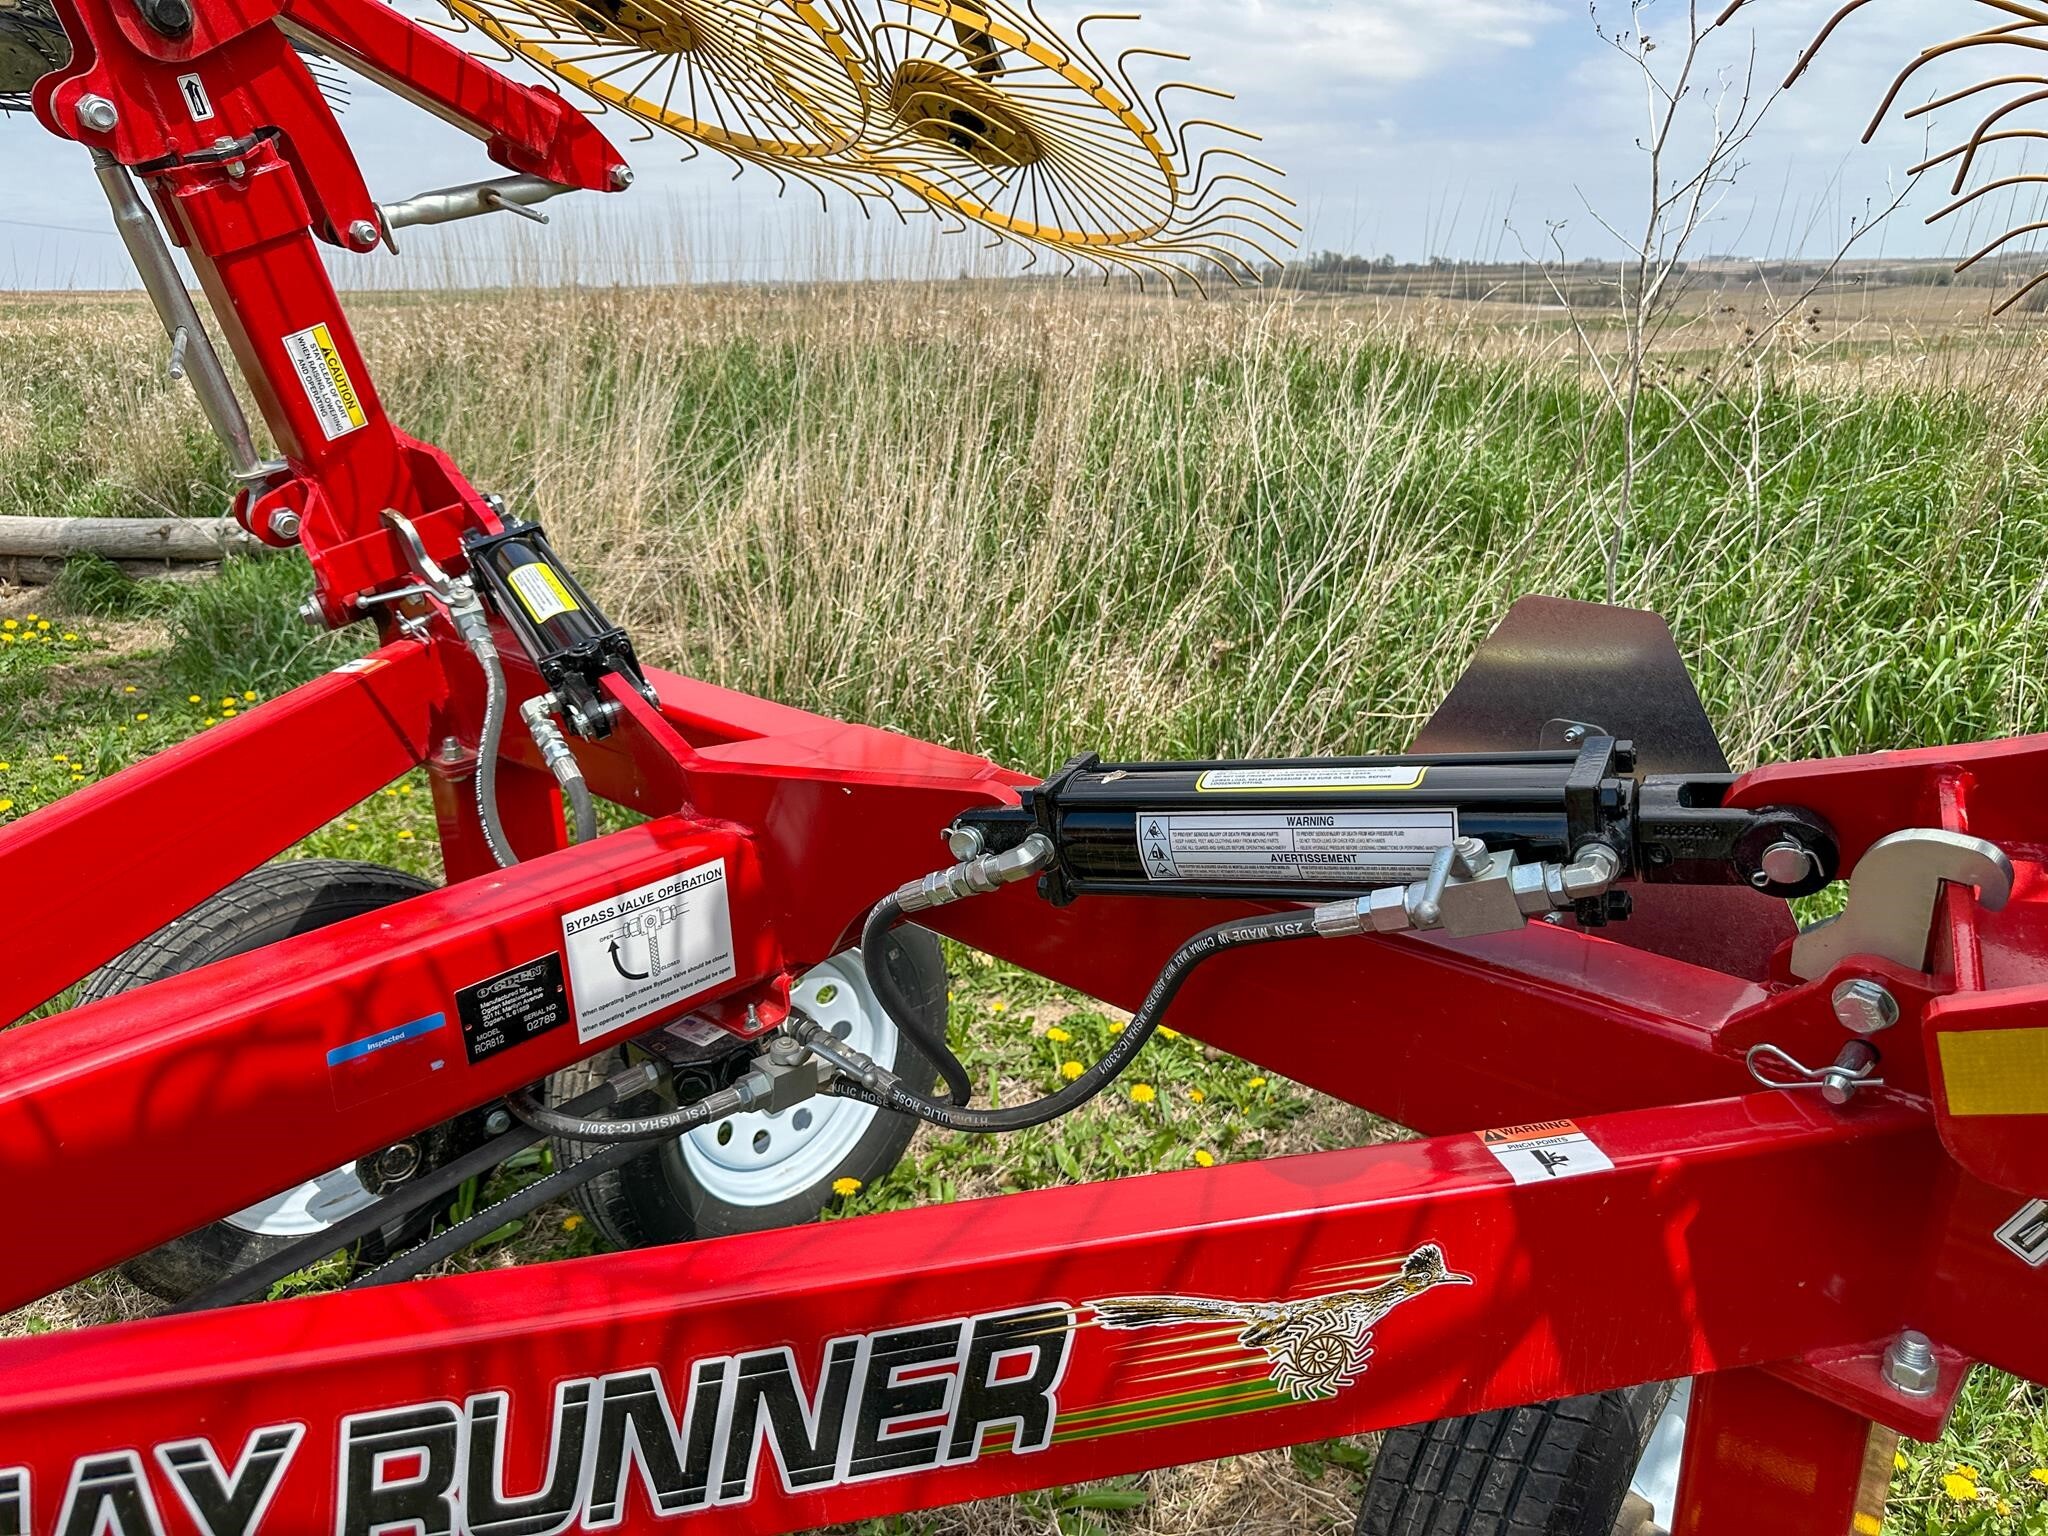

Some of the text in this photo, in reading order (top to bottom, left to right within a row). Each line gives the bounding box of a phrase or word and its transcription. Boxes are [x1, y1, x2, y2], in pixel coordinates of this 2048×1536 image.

[298, 336, 310, 359] WHEN
[323, 393, 344, 432] LOWERING
[298, 359, 328, 417] AND OPERATING
[310, 343, 347, 419] STAY CLEAR OF CART
[328, 358, 356, 409] CAUTION
[1286, 816, 1334, 826] WARNING
[1270, 854, 1357, 864] AVERTISSEMENT
[566, 868, 722, 933] BYPASS VALVE OPERATION
[1232, 926, 1266, 940] MADE
[1275, 921, 1302, 934] 2SN
[599, 934, 614, 943] OPEN
[1188, 935, 1214, 953] CHINA
[1217, 932, 1229, 943] IN
[661, 960, 680, 970] CLOSED
[1172, 948, 1188, 967] MAX
[1163, 961, 1176, 979] W/P
[582, 952, 728, 1018] When operating both rakes Bypass Valve should be closed
[480, 990, 518, 1009] Manufactured
[482, 1004, 501, 1017] Ogden
[501, 992, 532, 1008] Metalworks
[482, 1013, 494, 1022] 301
[522, 992, 544, 1006] Avenue
[582, 966, 731, 1033] When operating with one rake Bypass Valve should be open
[1143, 993, 1156, 1012] PSI
[484, 1016, 506, 1028] Ogden,
[524, 1008, 545, 1022] SERIAL
[526, 1012, 556, 1032] 02789
[1125, 1011, 1146, 1038] MSHA
[367, 1032, 406, 1050] Inspected
[474, 1034, 505, 1054] RCR812
[476, 1028, 500, 1042] MODEL
[1098, 1036, 1128, 1074] IC-330/1
[861, 1091, 889, 1107] HOSE
[892, 1089, 920, 1112] HOSE
[578, 1106, 707, 1134] PSI MSHA IC-330/1
[1500, 1120, 1571, 1136] WARNING
[1507, 1137, 1569, 1150] PINCH POINTS
[340, 1301, 1077, 1536] RUNNER
